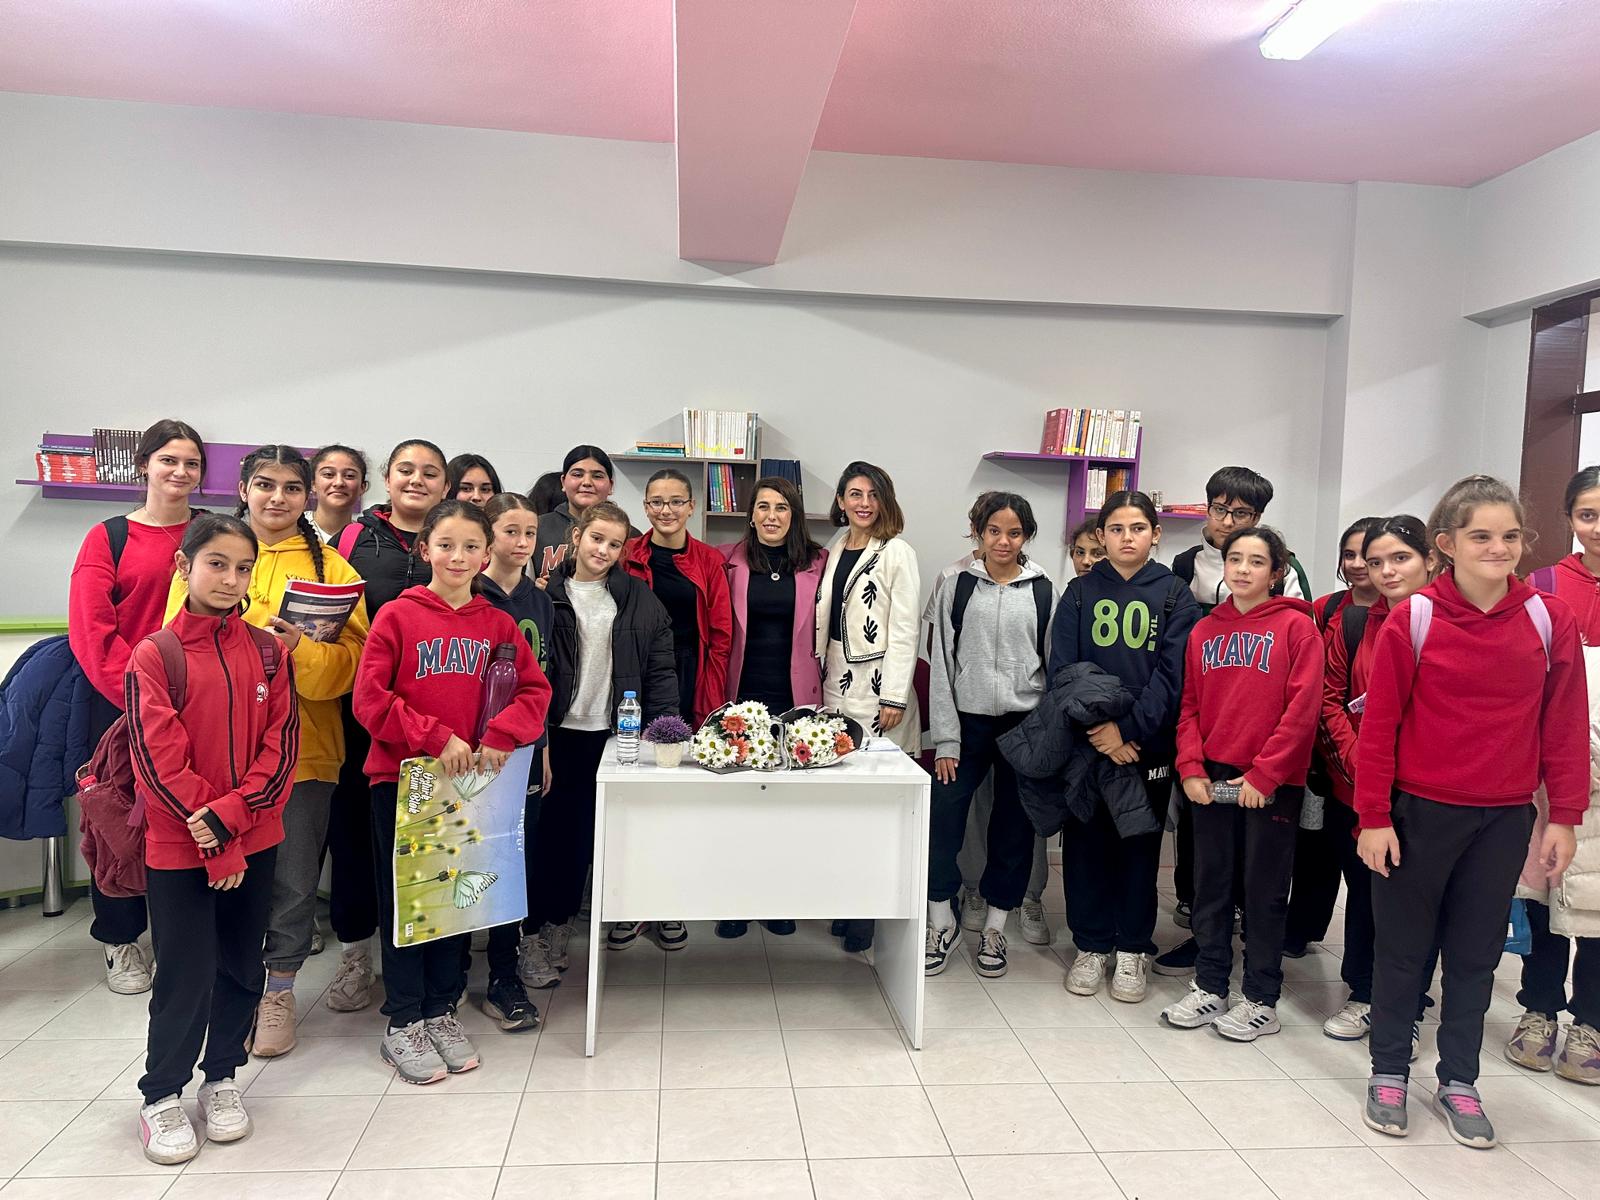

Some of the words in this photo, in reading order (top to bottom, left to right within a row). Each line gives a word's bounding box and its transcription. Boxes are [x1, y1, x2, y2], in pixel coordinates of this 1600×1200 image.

[416, 637, 490, 683] MAVİ
[1202, 631, 1274, 675] MAVİ
[410, 765, 422, 790] Resim
[408, 792, 421, 814] Blok
